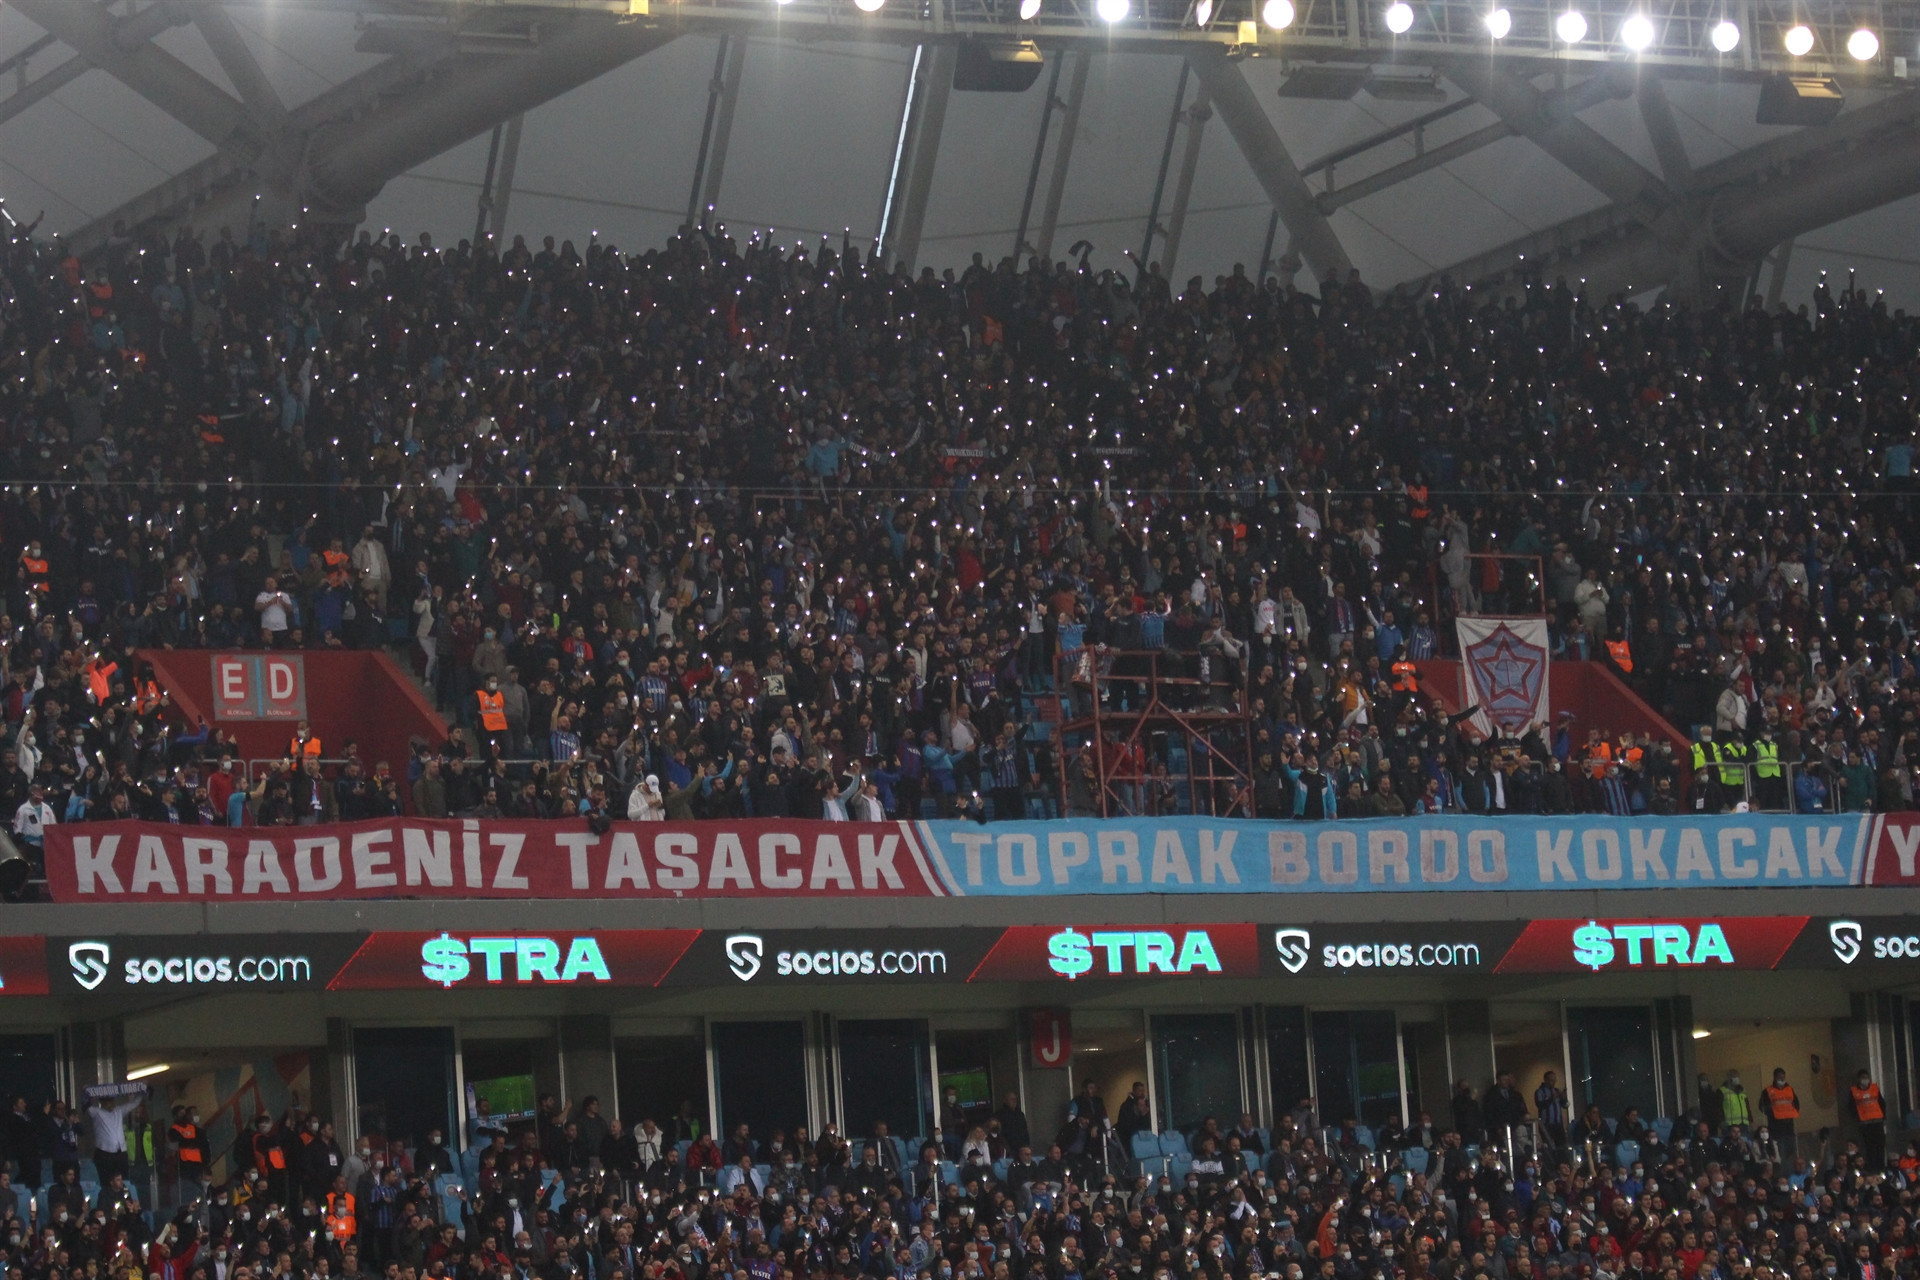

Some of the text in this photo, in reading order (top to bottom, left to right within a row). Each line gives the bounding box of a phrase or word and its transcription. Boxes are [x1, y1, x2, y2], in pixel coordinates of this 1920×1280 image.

[222, 663, 245, 699] E
[269, 663, 294, 699] D
[73, 820, 529, 894] KARADENİZ
[555, 832, 905, 897] TAŞACAK
[951, 830, 1240, 886] TOPRAK
[1268, 829, 1508, 885] BORDO
[1536, 827, 1845, 883] KOKACAK
[421, 932, 611, 988] $TRA
[777, 951, 946, 975] socios.com
[1047, 927, 1222, 980] $TRA
[1323, 944, 1479, 968] socios.com
[1572, 921, 1734, 971] $TRA
[125, 957, 310, 984] socios.com
[1042, 1021, 1060, 1062] J
